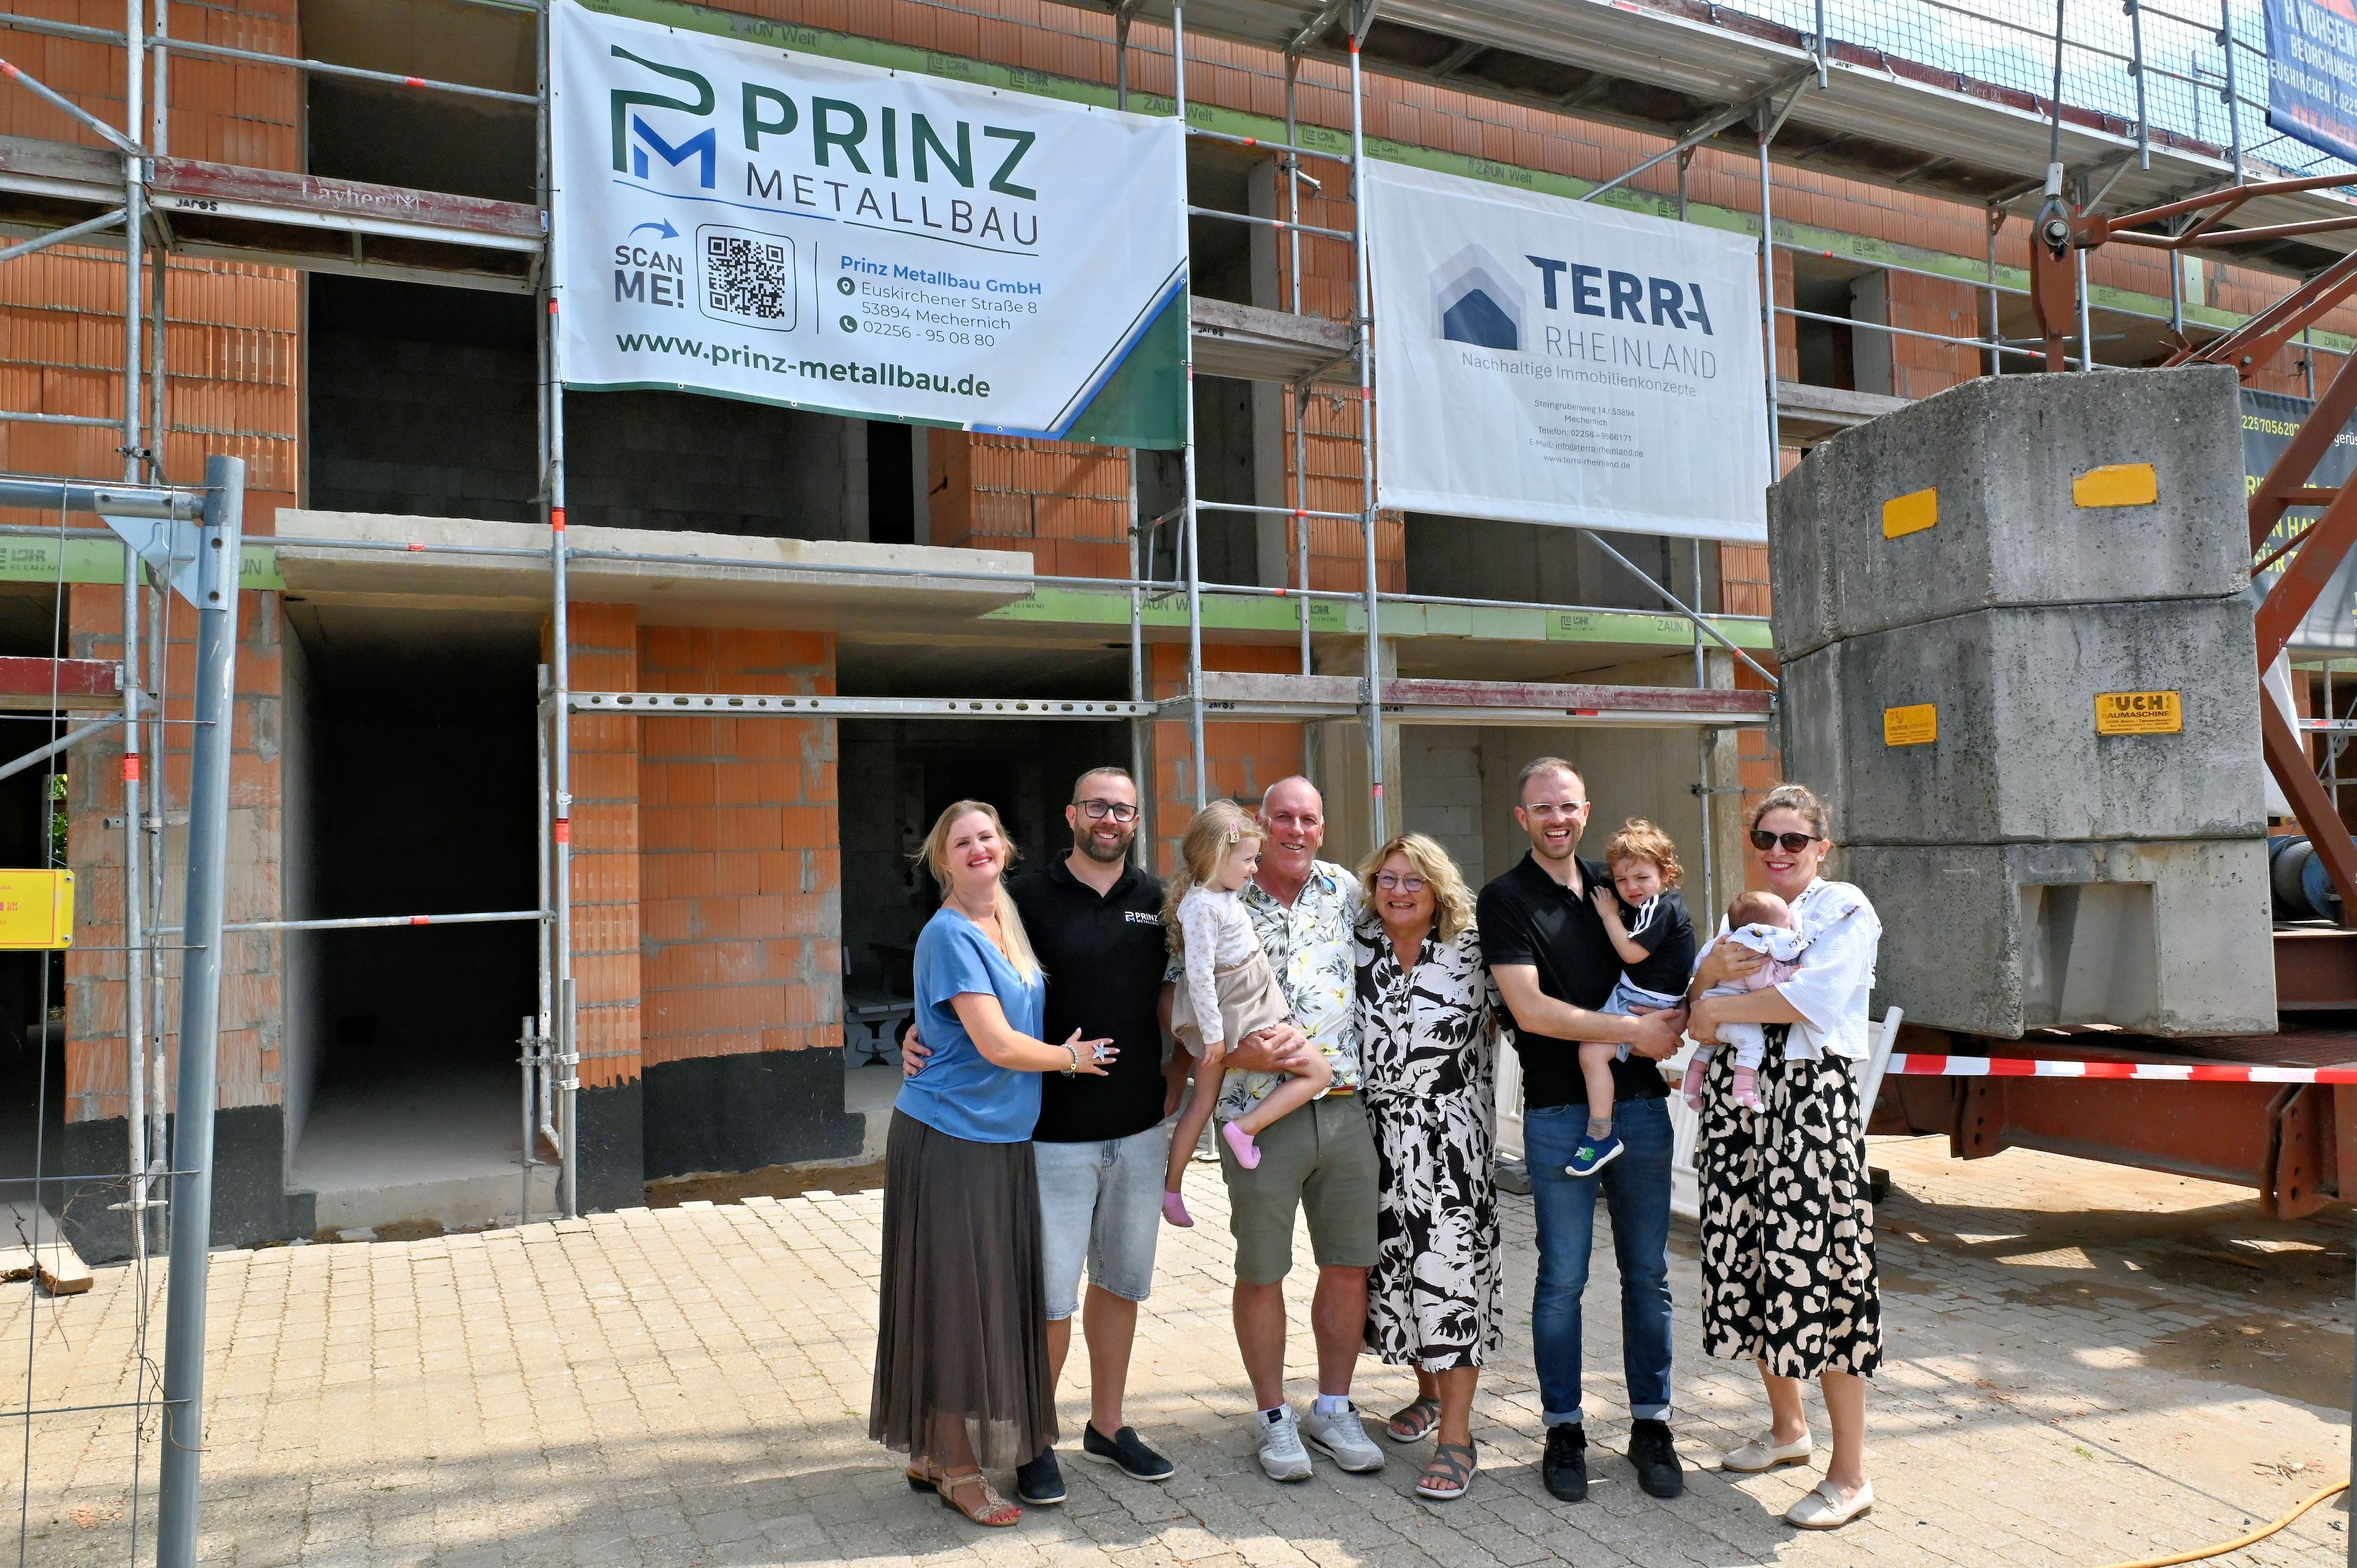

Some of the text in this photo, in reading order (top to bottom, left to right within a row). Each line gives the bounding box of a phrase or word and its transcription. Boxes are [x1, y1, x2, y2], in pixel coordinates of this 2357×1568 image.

[731, 23, 816, 47] AUN Welt
[2290, 33, 2357, 87] BEDACHUNGE
[1185, 105, 1213, 123] Welt
[742, 82, 1036, 201] PRINZ
[1509, 169, 1532, 184] Welt
[747, 161, 1038, 245] METALLBAU
[615, 245, 682, 275] SCAN
[841, 255, 1041, 295] Prinz Metallbau GmbH
[615, 270, 684, 309] ME!
[862, 282, 1037, 313] Euskirchener Straße 8
[1524, 255, 1714, 336] TERRA
[862, 302, 1011, 329] 53894 Mechernich
[863, 321, 911, 339] 02256
[926, 329, 945, 342] 95
[949, 332, 970, 345] 08
[975, 334, 995, 347] 80
[616, 334, 991, 398] www.prinz-metallbau.de
[1546, 326, 1716, 379] RHEINLAND
[1463, 352, 1696, 397] Nachhaltige Immobilienkonzepte
[1534, 400, 1596, 414] Steingrubenweg
[1612, 408, 1635, 417] 53894
[1564, 415, 1607, 426] Mechernich
[1529, 438, 1643, 457] E-Mail: info@terra-rheinland.de
[1538, 426, 1569, 436] Telefon:
[1570, 430, 1594, 438] 02256
[1601, 433, 1632, 442] 9566171
[1544, 455, 1630, 469] www.terra-rheinland.de
[1658, 619, 1683, 632] ZAUN
[1135, 912, 1158, 922] PRINZ
